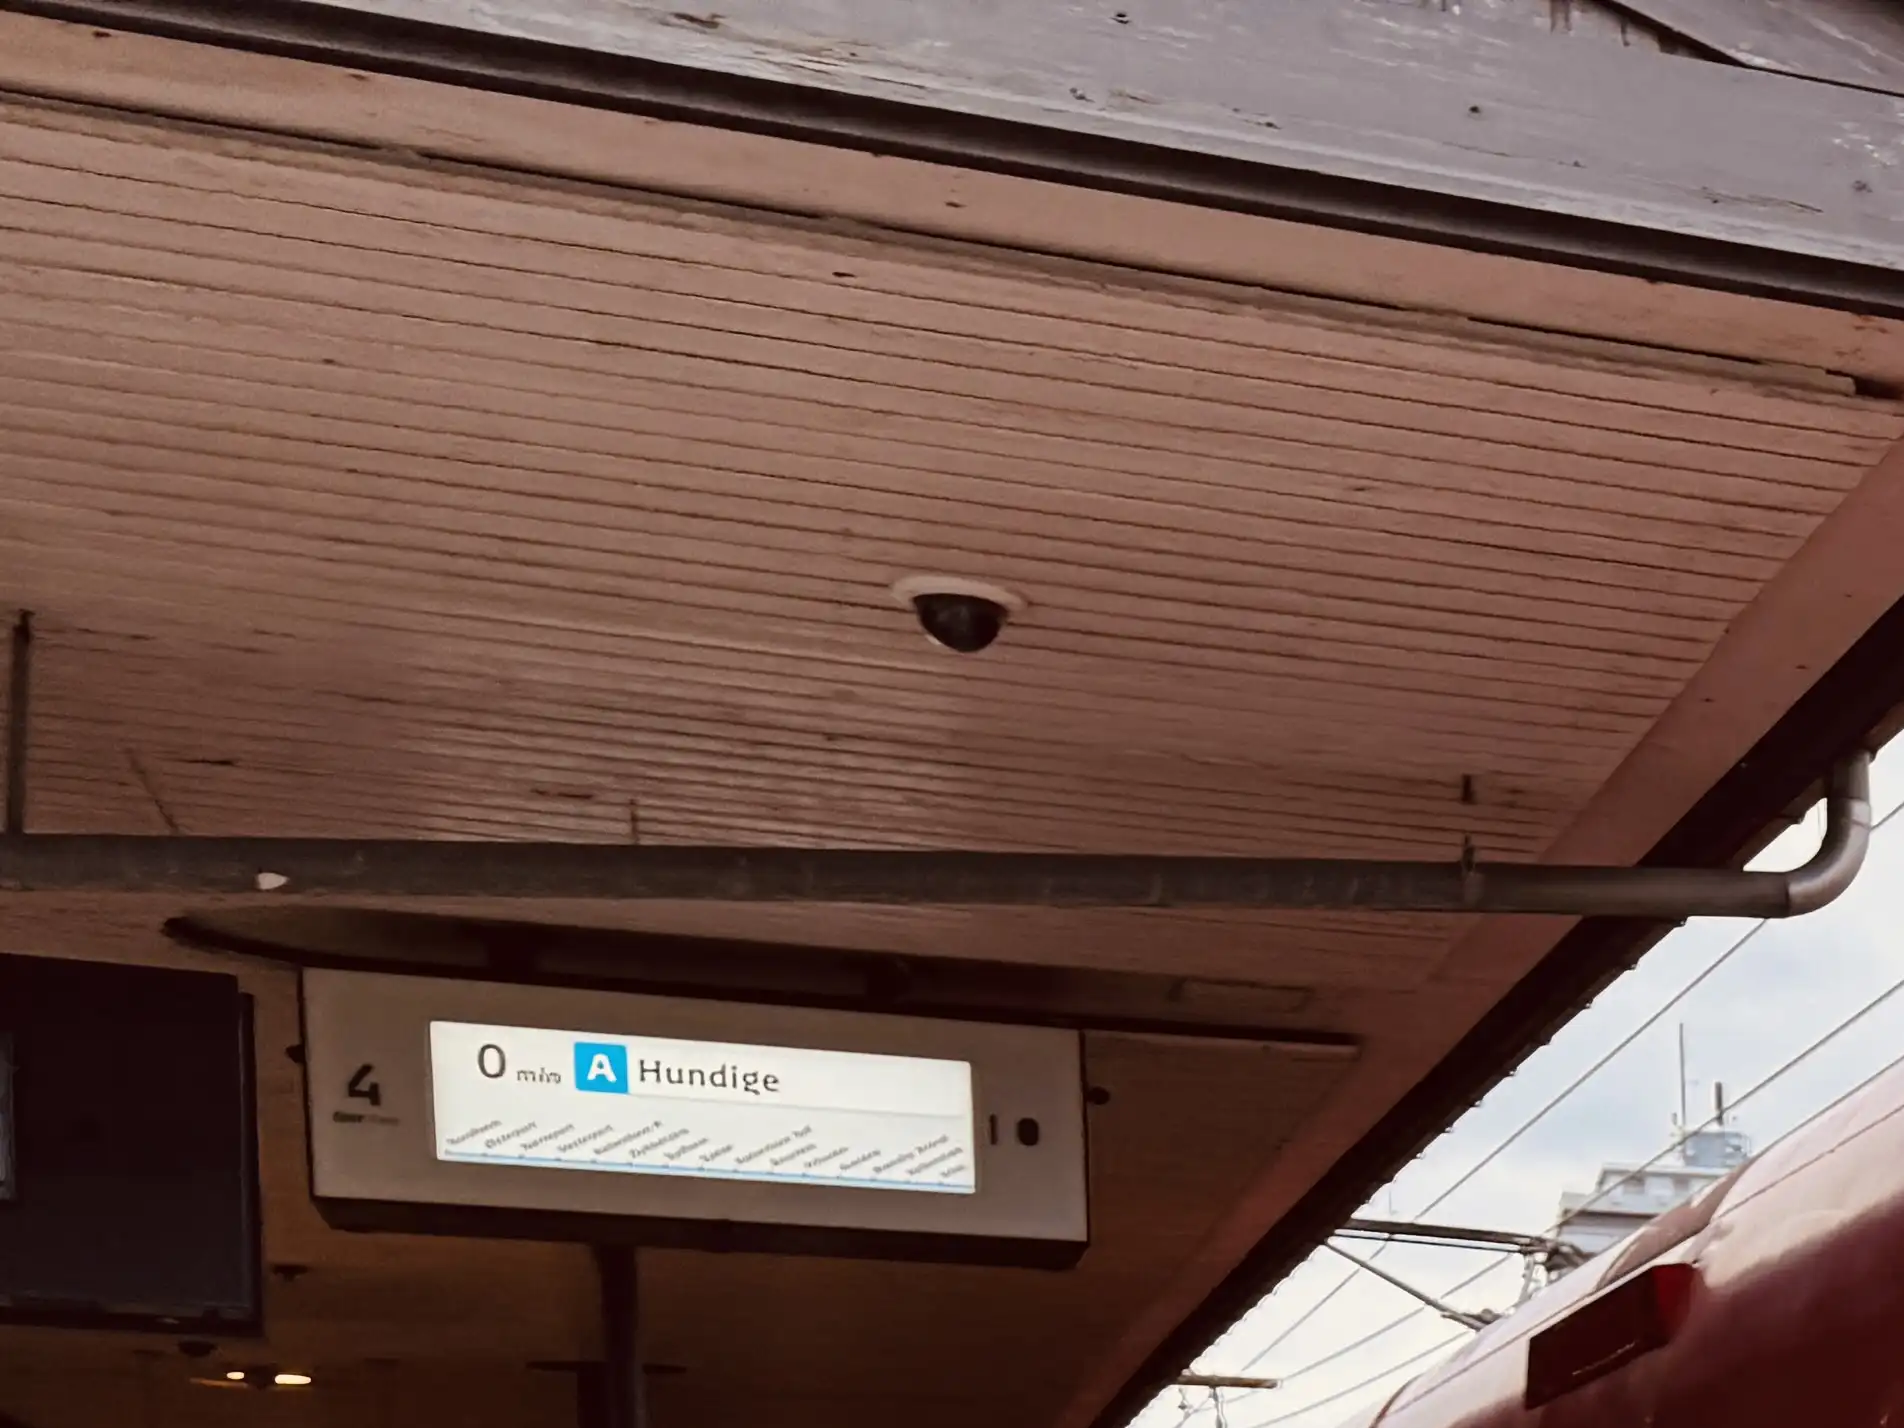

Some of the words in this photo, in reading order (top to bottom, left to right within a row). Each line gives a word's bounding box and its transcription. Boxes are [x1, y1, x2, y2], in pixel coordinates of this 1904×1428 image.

[347, 1063, 382, 1107] 4
[477, 1043, 507, 1079] 0
[586, 1052, 617, 1083] A
[638, 1058, 781, 1095] Hundige
